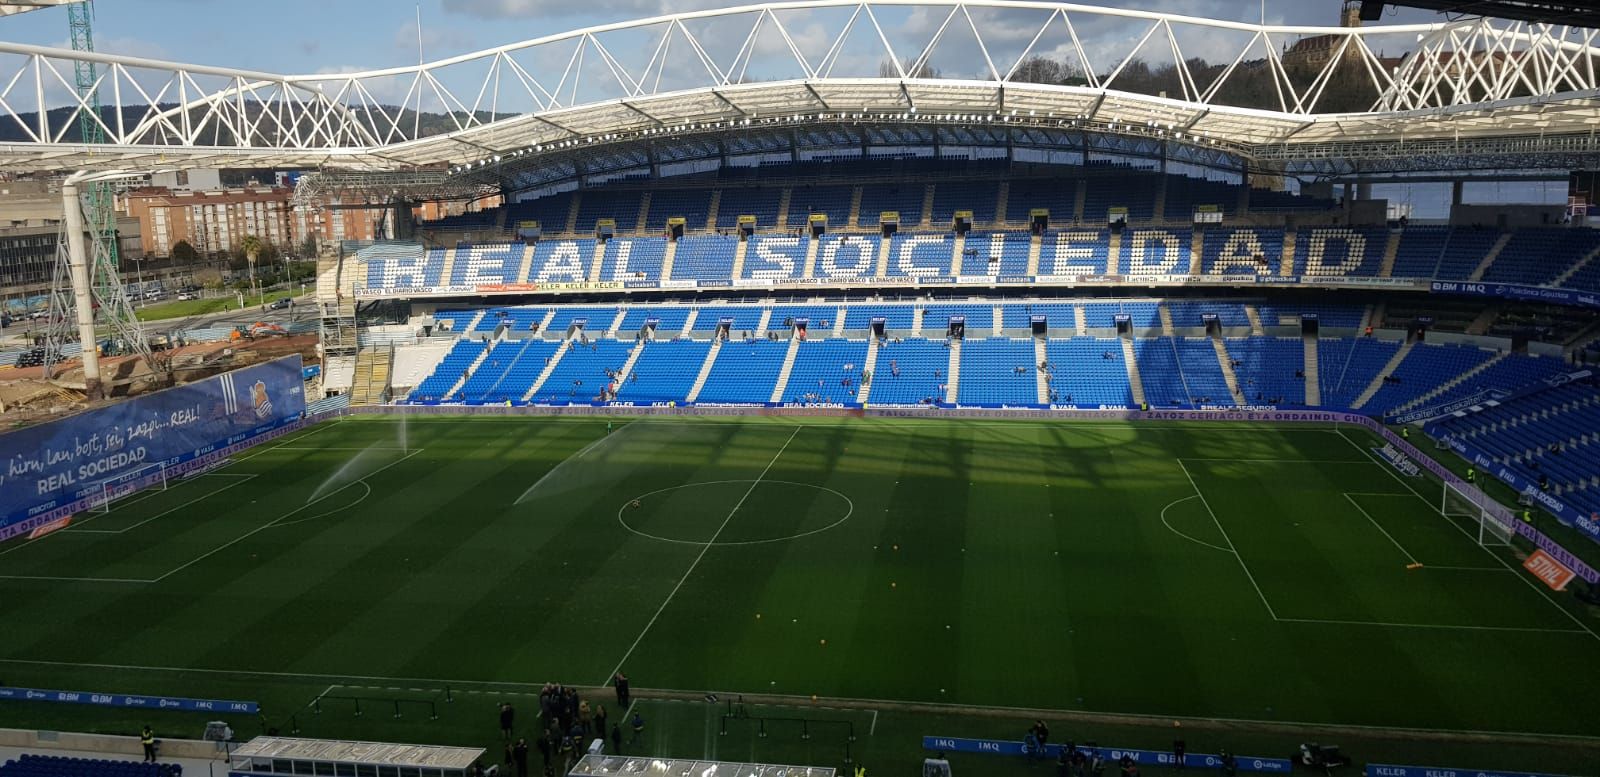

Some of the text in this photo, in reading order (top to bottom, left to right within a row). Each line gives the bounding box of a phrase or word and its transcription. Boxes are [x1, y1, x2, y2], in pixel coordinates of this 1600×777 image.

[382, 228, 1367, 288] REAL SOCIEDAD
[1442, 283, 1457, 291] BM
[1443, 395, 1481, 415] euskaltel
[1147, 411, 1185, 419] ZATOZ
[1190, 412, 1244, 420] GEHIAGO
[1396, 408, 1434, 424] euskaltel
[75, 433, 102, 457] bost,
[37, 446, 146, 495] REAL SOCIEDAD
[1526, 484, 1564, 513] REAL SOCIEDAD
[21, 503, 76, 530] ORDAINDU
[1529, 555, 1563, 583] STIHL
[66, 693, 80, 701] BM
[99, 695, 113, 703] BM
[195, 701, 213, 710] IMQ
[230, 703, 248, 711] IMQ
[935, 739, 955, 748] IMQ
[978, 742, 1000, 752] IMQ
[1376, 767, 1407, 776] KELER
